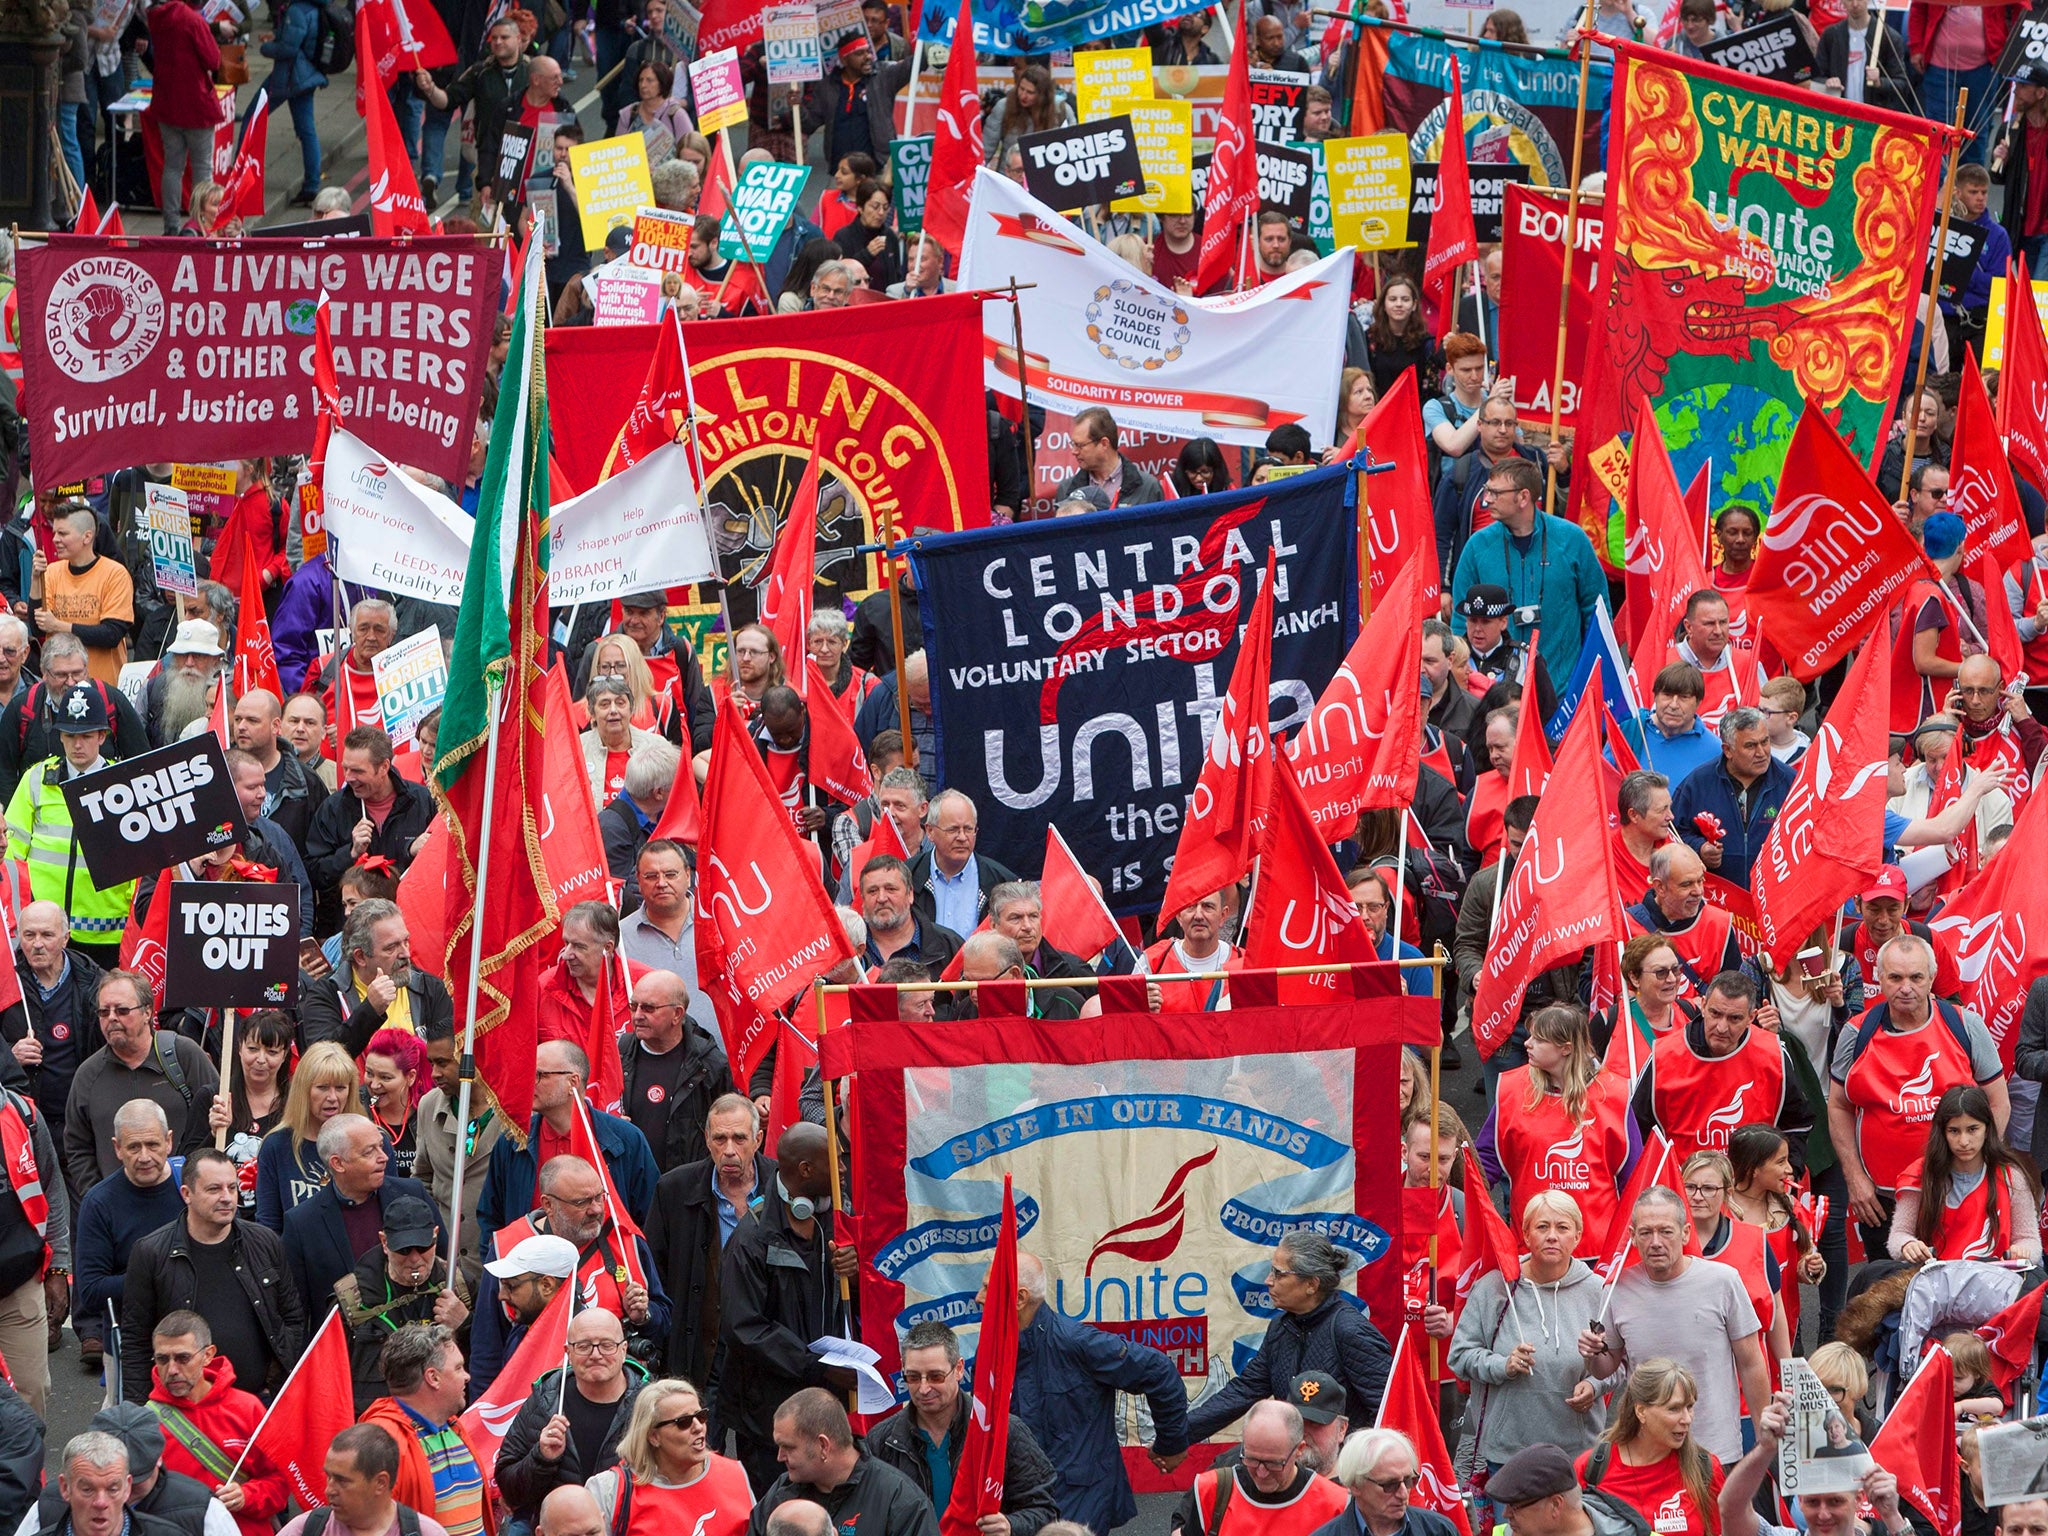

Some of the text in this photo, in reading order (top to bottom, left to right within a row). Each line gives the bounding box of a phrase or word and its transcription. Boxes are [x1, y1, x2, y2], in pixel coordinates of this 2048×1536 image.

[1088, 0, 1201, 35] UNISON
[765, 24, 817, 40] TORIES
[768, 38, 817, 58] OUT!
[1712, 28, 1797, 67] TORIES
[693, 64, 730, 85] Solidarity
[1094, 58, 1132, 70] FUND
[1738, 50, 1787, 76] OUT
[712, 78, 727, 90] the
[1083, 70, 1145, 85] OUR NHS
[1273, 74, 1300, 83] Worker
[1483, 67, 1503, 83] the
[1518, 72, 1580, 95] union
[1100, 85, 1130, 96] AND
[1253, 84, 1302, 107] EFY
[1132, 109, 1171, 120] FUND
[1251, 104, 1299, 126] ORY
[1492, 94, 1533, 131] legal
[1133, 123, 1184, 134] UR NHS
[1702, 91, 1854, 160] CYMRU
[501, 133, 528, 161] TORIES
[1029, 129, 1127, 169] TORIES
[1136, 136, 1167, 147] AND
[1347, 146, 1387, 159] FUND
[580, 154, 641, 177] OUR NHS
[589, 146, 627, 162] FUND
[1138, 150, 1177, 160] UBLIC
[1335, 158, 1402, 173] OUR NHS
[1717, 132, 1836, 191] WALES
[500, 158, 517, 180] OUT
[598, 171, 627, 187] AND
[746, 165, 804, 191] CUT
[1054, 155, 1112, 187] OUT
[1143, 164, 1185, 175] VICES
[1257, 154, 1307, 186] ORIES
[1353, 173, 1386, 185] AND
[590, 181, 639, 201] PUBLIC
[736, 186, 793, 212] WAR
[1257, 178, 1294, 205] OUT
[1345, 185, 1398, 199] PUBLIC
[585, 192, 648, 215] SERVICES
[1338, 199, 1406, 214] SERVICES
[637, 217, 689, 235] KICK THE
[724, 208, 784, 234] NOT
[1708, 190, 1834, 261] unite
[638, 229, 687, 250] TORIES
[633, 242, 685, 273] OUT!
[62, 261, 153, 294] WOMEN'S
[171, 252, 474, 297] A LIVING WAGE
[600, 281, 647, 297] Solidarity
[600, 293, 640, 306] with the
[169, 301, 226, 337] FOR
[599, 304, 645, 318] Windrush
[1114, 299, 1166, 323] SLOUGH
[47, 298, 161, 374] GLOBAL STRIKE
[1113, 315, 1161, 337] TRADES
[1105, 327, 1161, 351] COUNCIL
[166, 346, 468, 396] & OTHER CARERS
[1047, 377, 1183, 406] SOLIDARITY IS POWER
[54, 388, 167, 443] Survival,
[177, 389, 274, 422] Justice
[283, 394, 299, 419] &
[700, 411, 817, 461] UNION
[174, 477, 228, 491] Islamophobia
[175, 466, 227, 481] Fight against
[351, 470, 387, 494] unite
[58, 483, 84, 496] Prevent
[204, 493, 220, 505] civil
[150, 510, 190, 537] TORIES
[352, 502, 379, 520] your
[383, 514, 415, 534] voice
[623, 507, 644, 522] Help
[577, 537, 609, 552] shape
[612, 529, 633, 546] your
[635, 511, 700, 536] community
[153, 531, 191, 563] OUT!
[983, 519, 1298, 599] CENTRAL
[394, 551, 440, 574] LEEDS
[565, 556, 623, 580] BRANCH
[373, 563, 443, 598] Equality
[590, 568, 638, 592] for All
[1005, 564, 1289, 647] LONDON
[379, 647, 441, 693] TORIES
[949, 628, 1222, 691] VOLUNTARY SECTOR
[385, 668, 445, 717] OUT!
[80, 754, 214, 822] TORIES
[119, 792, 198, 842] OUT
[1112, 865, 1142, 895] IS
[181, 902, 290, 937] TORIES
[202, 937, 269, 970] OUT
[1889, 1095, 1941, 1114] unite
[950, 1098, 1313, 1165] SAFE IN OUR HANDS
[1535, 1160, 1590, 1180] unite
[1549, 1181, 1590, 1190] theUNION
[1224, 1206, 1383, 1253] PROGRESSIVE
[1056, 1267, 1209, 1321] unite
[909, 1300, 983, 1326] SOLIDA
[1800, 1382, 1821, 1391] THIS
[1800, 1400, 1829, 1412] MUST
[1654, 1509, 1685, 1519] unite
[1662, 1523, 1687, 1532] HEALTH
